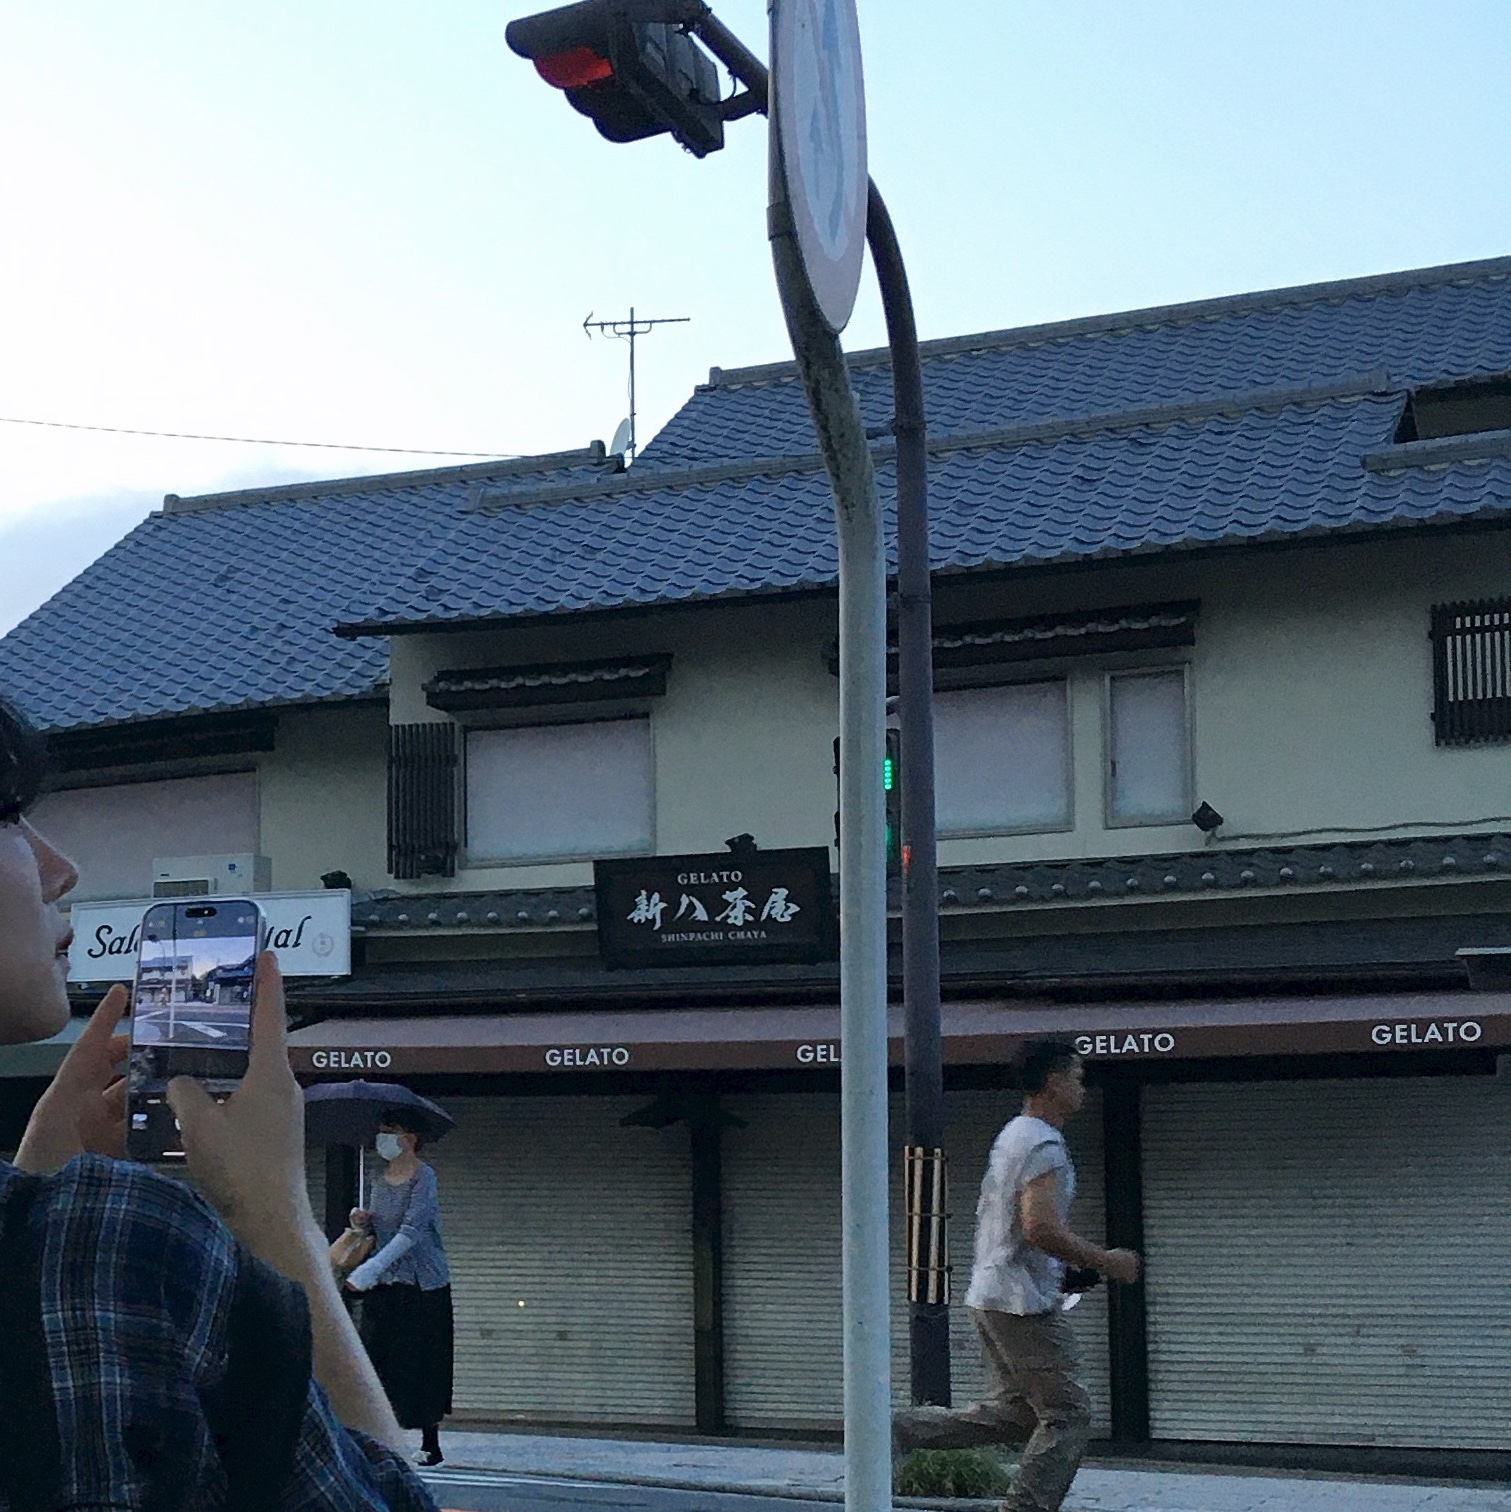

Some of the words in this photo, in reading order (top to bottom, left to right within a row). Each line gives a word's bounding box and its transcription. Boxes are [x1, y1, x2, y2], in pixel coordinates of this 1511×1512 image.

[677, 870, 743, 885] GELATO
[626, 887, 801, 931] 新八茶屋
[87, 923, 140, 959] Sal
[660, 931, 724, 943] SHINPACHI
[728, 930, 768, 940] CHAYA
[1371, 1021, 1482, 1045] GELATO
[796, 1044, 842, 1063] GEL
[1075, 1033, 1175, 1055] GELATO
[312, 1051, 392, 1068] GELATO
[545, 1047, 630, 1067] GELATO
